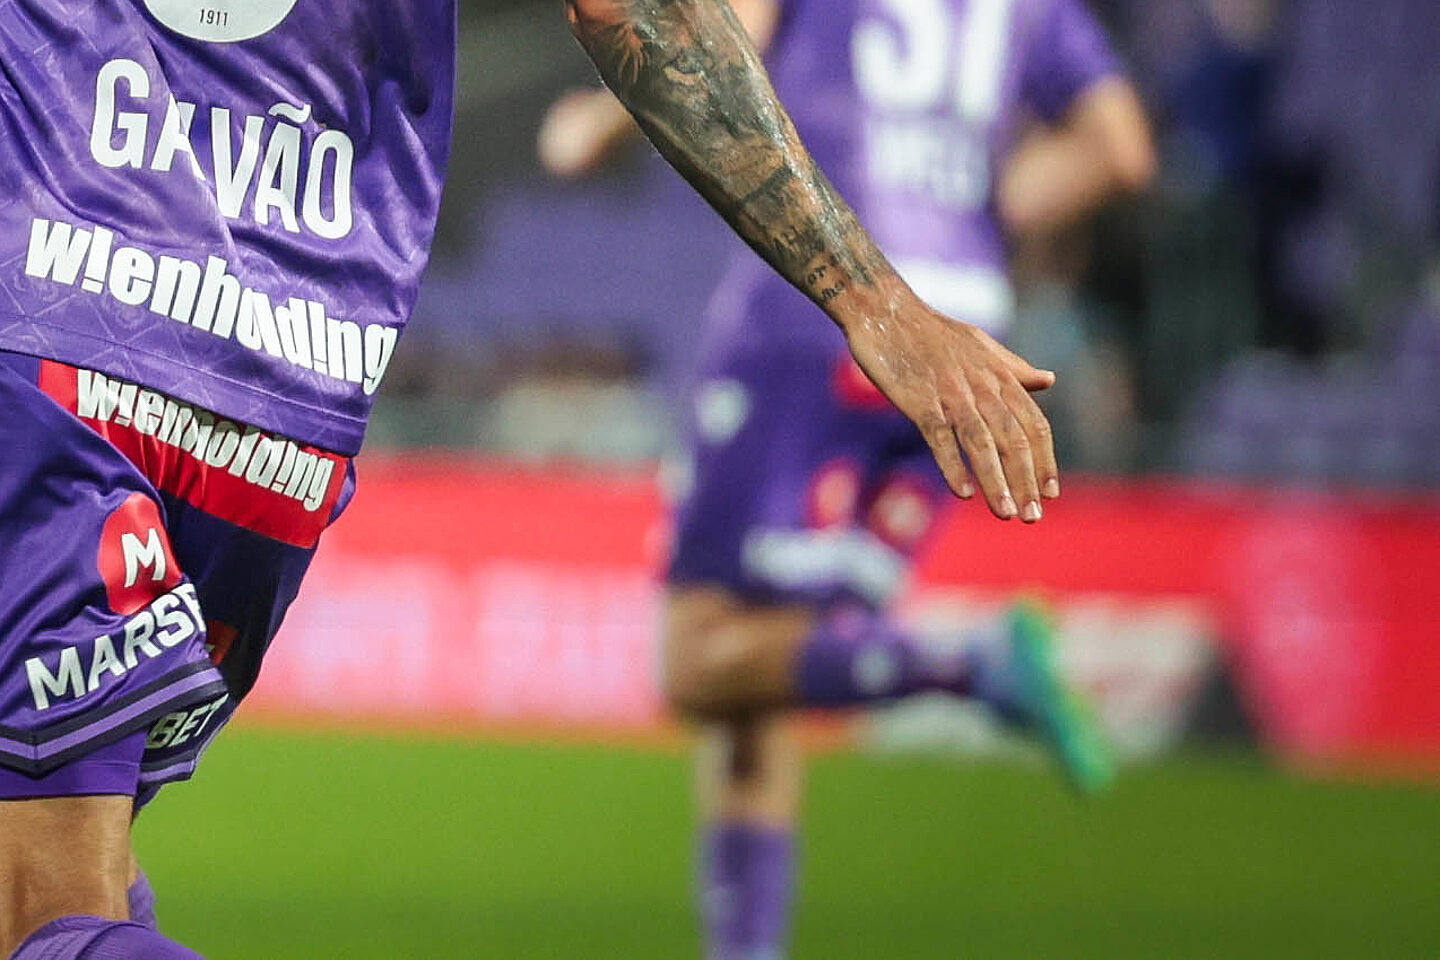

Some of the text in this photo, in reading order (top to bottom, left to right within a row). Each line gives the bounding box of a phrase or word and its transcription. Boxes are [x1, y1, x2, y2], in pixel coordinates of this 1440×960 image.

[199, 9, 229, 26] 1911
[90, 58, 355, 240] GAVÃO
[121, 528, 167, 588] M
